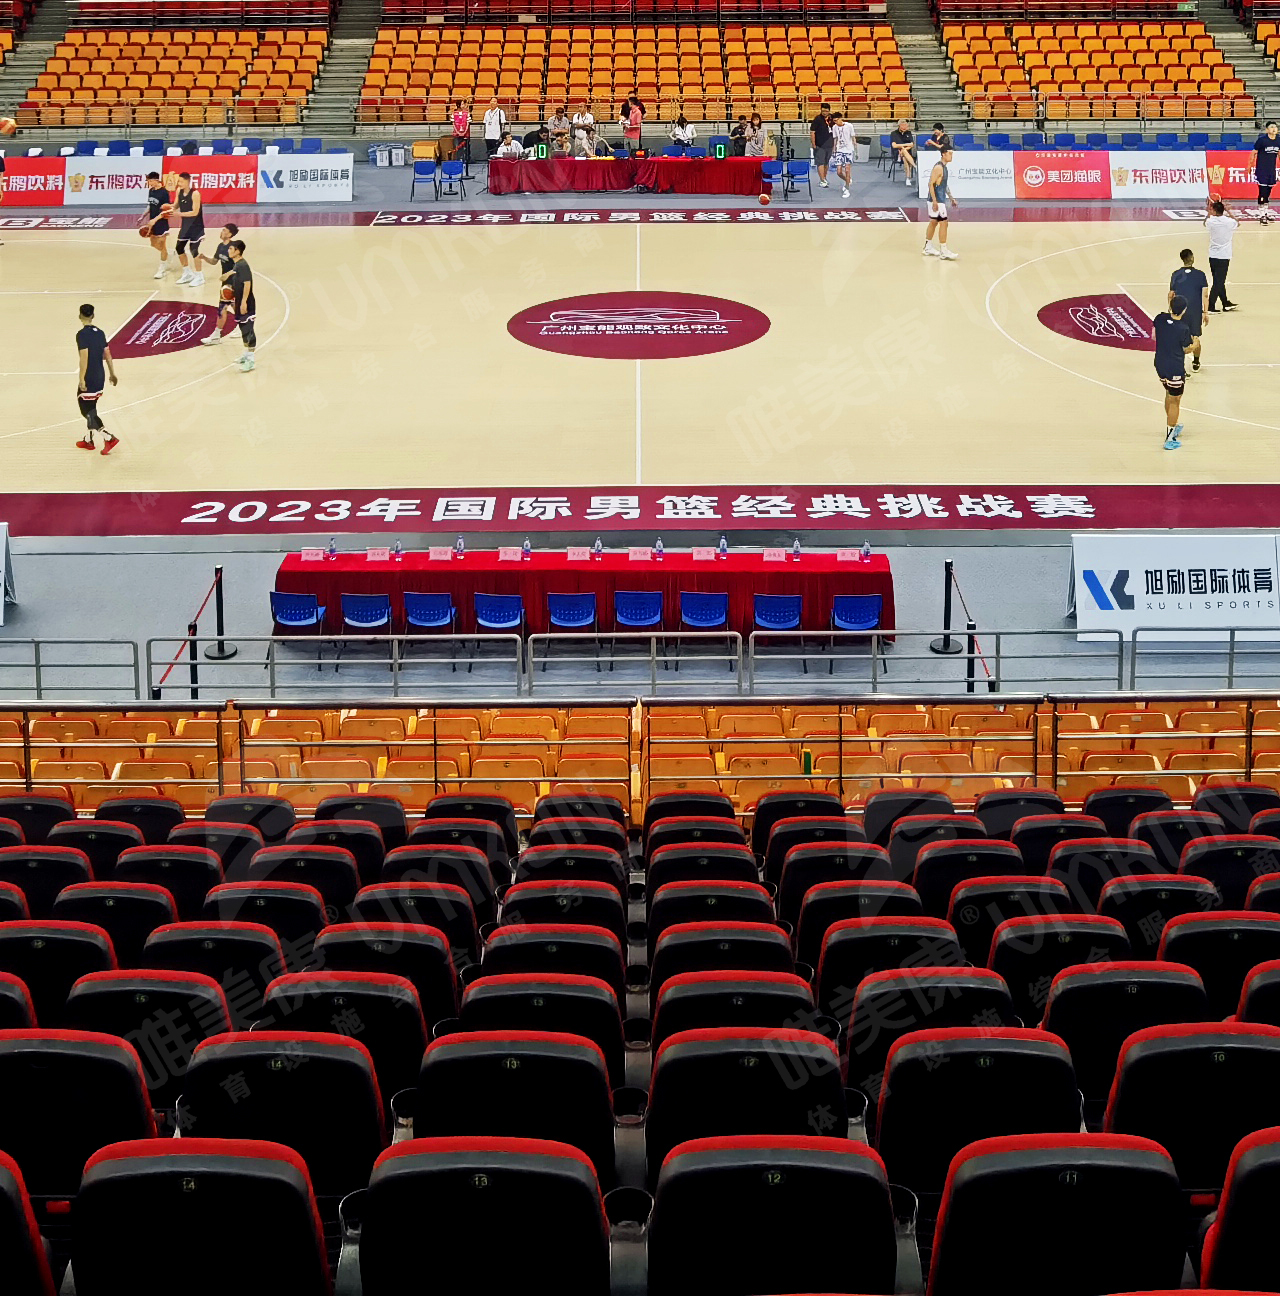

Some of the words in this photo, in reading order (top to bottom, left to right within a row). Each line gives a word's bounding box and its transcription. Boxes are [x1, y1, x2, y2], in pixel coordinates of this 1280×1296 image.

[288, 168, 350, 182] 旭励国际体育
[958, 168, 1012, 176] 广州宝能文化中心
[1048, 169, 1101, 183] 美团猫眼
[1132, 168, 1205, 184] 东鹏饮料
[88, 174, 150, 190] 东鹏饮
[378, 209, 904, 224] 2023年国际男篮经典挑战赛
[181, 495, 1096, 524] 2023年国际男篮经典挑战赛
[1144, 567, 1274, 595] 旭励国际体育
[1146, 600, 1166, 610] XU
[1204, 600, 1275, 610] SPORTS
